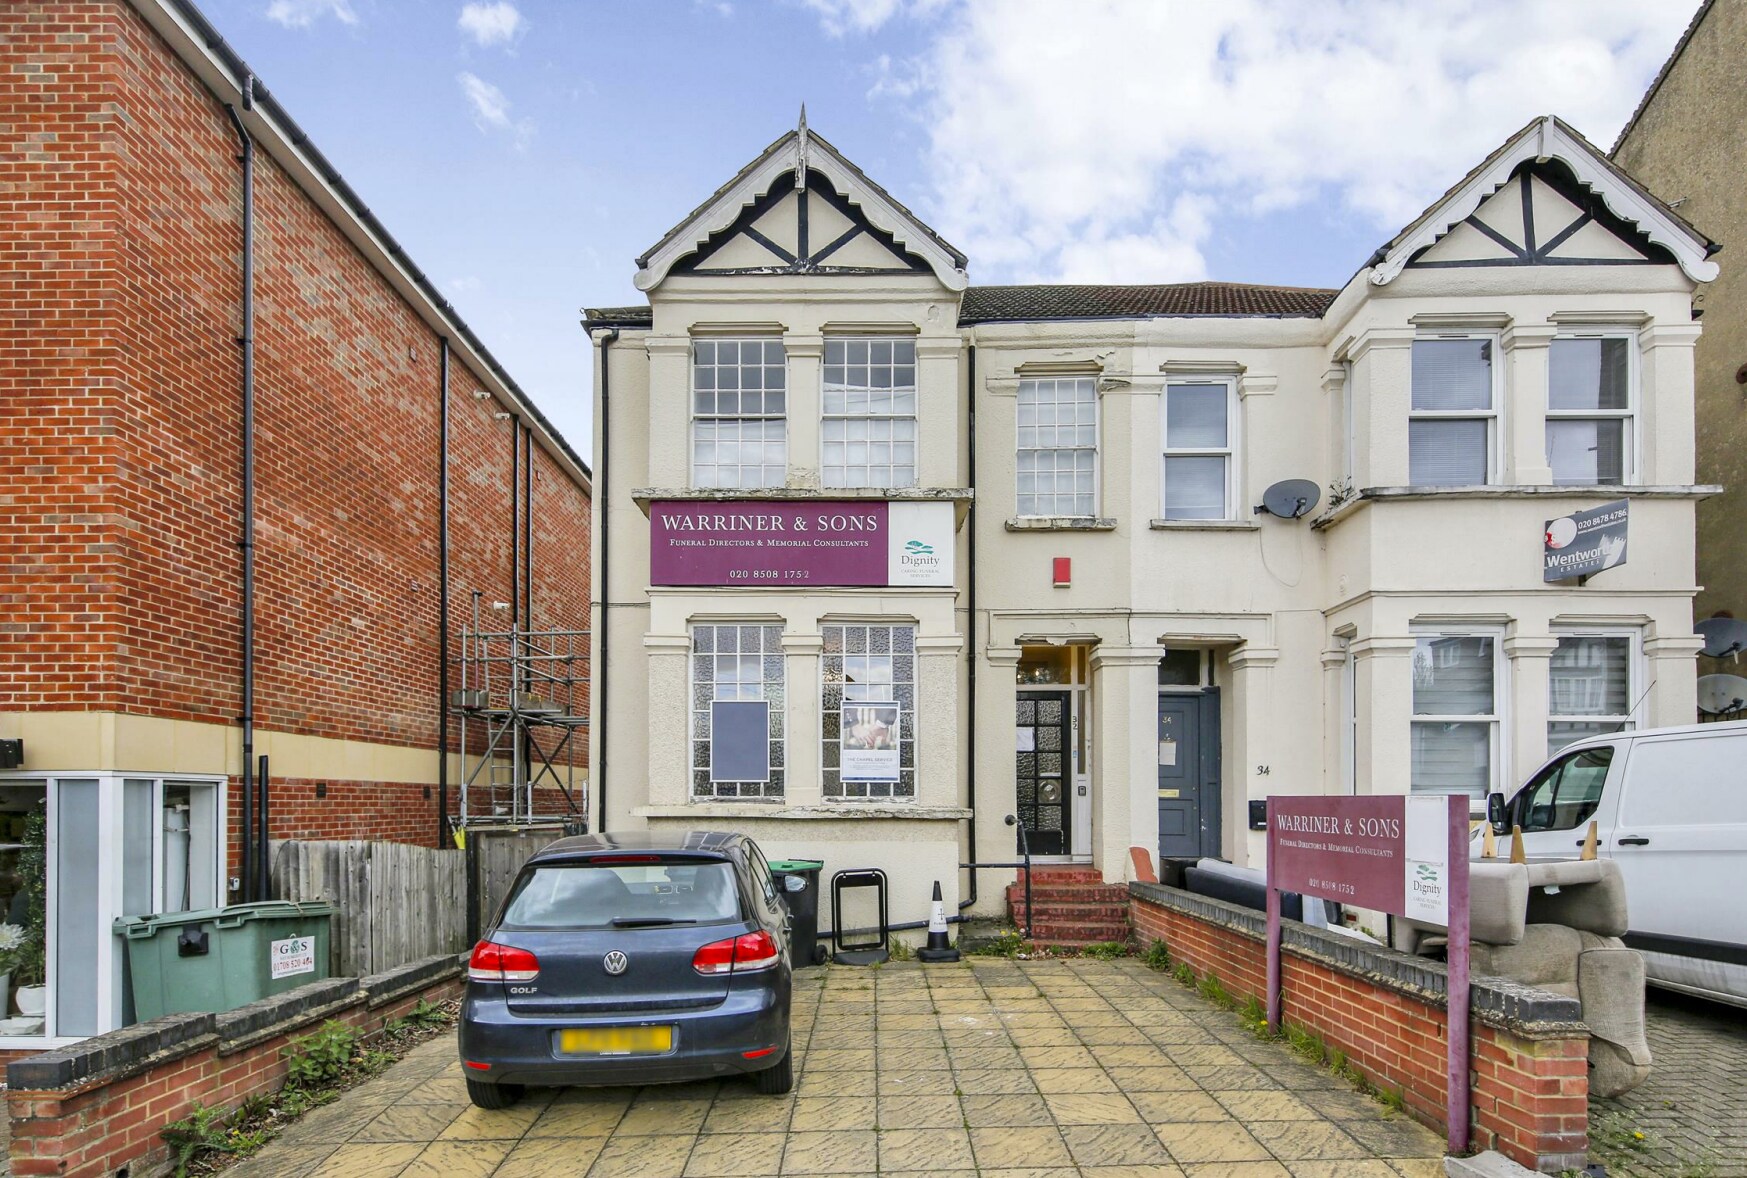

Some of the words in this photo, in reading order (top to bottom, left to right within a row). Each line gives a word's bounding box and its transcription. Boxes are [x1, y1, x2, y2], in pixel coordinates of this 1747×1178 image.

[661, 515, 785, 531] WARRINER
[793, 516, 808, 531] &
[818, 515, 877, 531] SONS
[1578, 519, 1592, 529] 020
[901, 555, 940, 567] Dignity
[729, 570, 748, 578] 020
[753, 570, 779, 578] 8508
[784, 570, 809, 579] 1752
[1256, 765, 1270, 776] 34
[1277, 814, 1340, 834] WARRINER
[1344, 818, 1353, 835] &
[1359, 817, 1400, 839] SONS
[1338, 883, 1355, 895] 1752
[1413, 880, 1441, 897] Dignity
[280, 944, 289, 954] G
[300, 941, 308, 951] S
